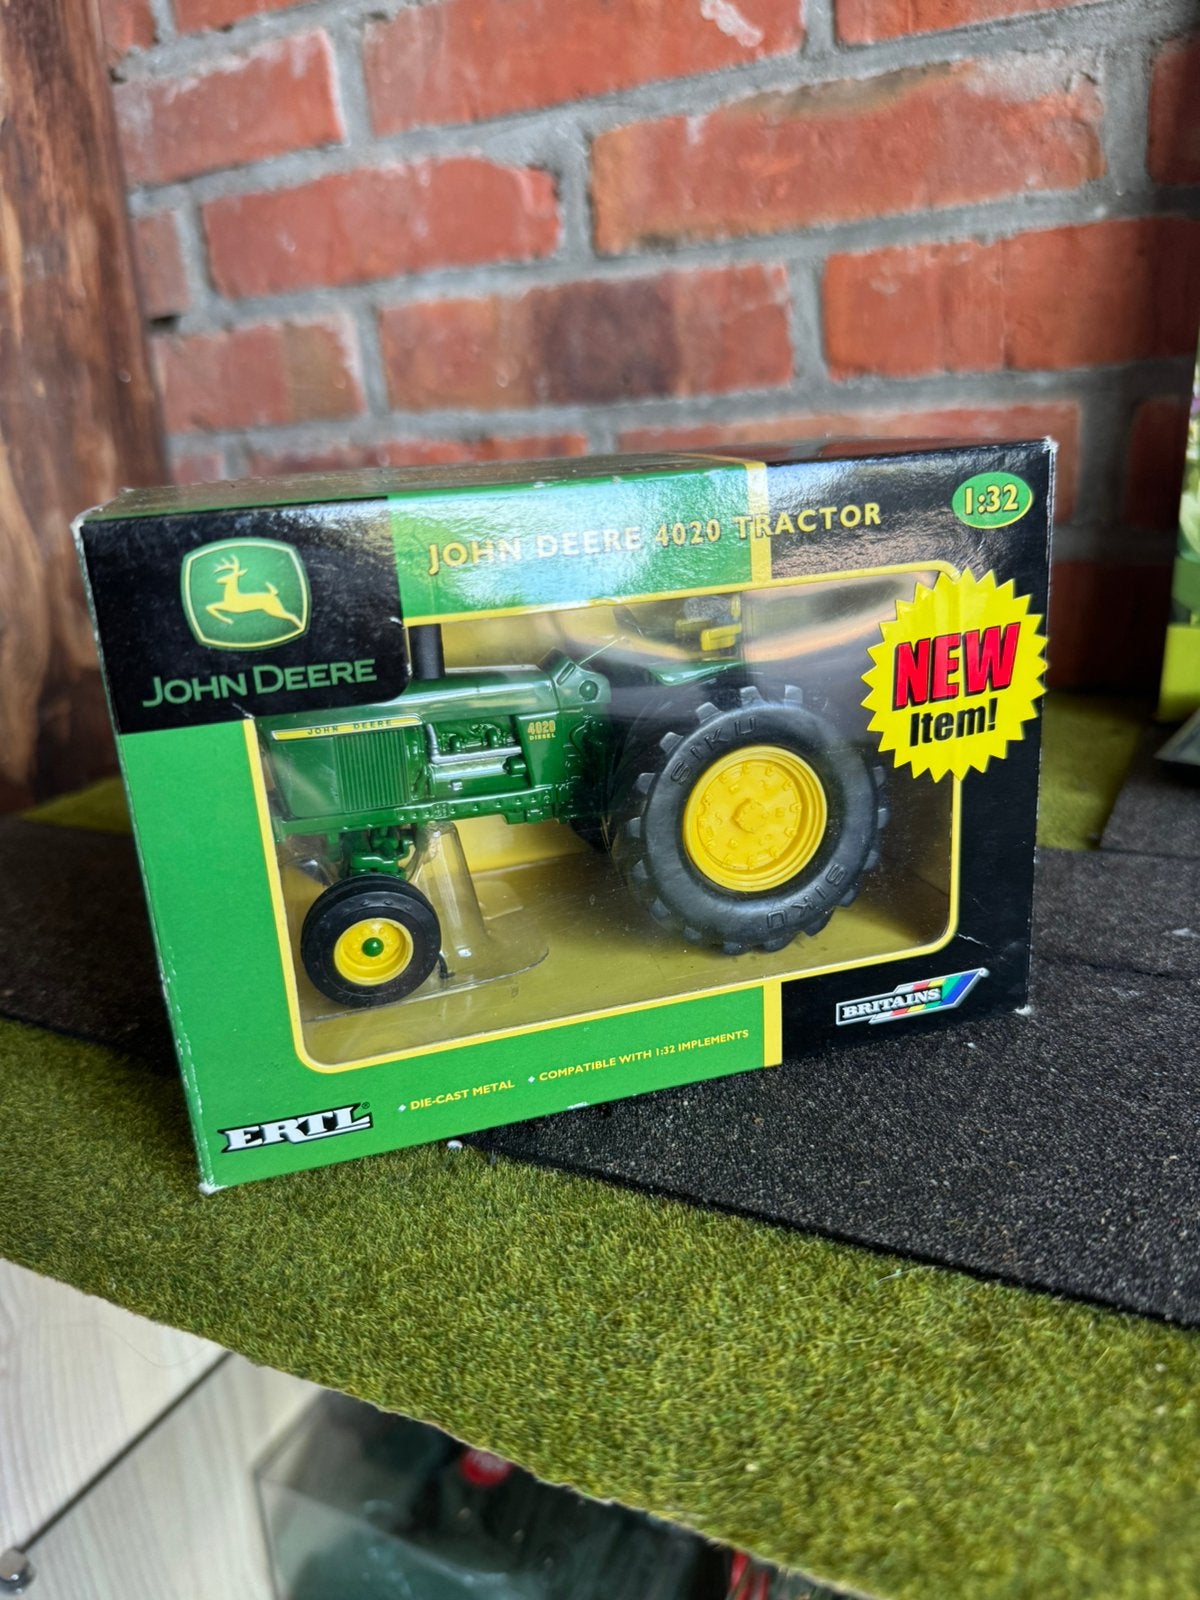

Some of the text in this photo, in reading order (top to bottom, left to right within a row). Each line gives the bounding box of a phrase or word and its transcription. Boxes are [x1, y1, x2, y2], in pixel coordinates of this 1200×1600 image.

[963, 482, 1019, 515] 1:32
[429, 501, 882, 576] JOHN DEERE 4020 TRACTOR
[142, 659, 377, 708] JOHN DEERE
[892, 622, 1021, 711] NEW
[307, 719, 392, 735] JOHN DEERE
[529, 733, 556, 741] DIESEL
[909, 698, 998, 747] Item!
[670, 718, 756, 786] SIKU
[842, 987, 942, 1020] BRITAINS
[539, 1029, 749, 1081] COMPATIBLE WITH 1:32 IMPLEMENTS
[410, 1080, 515, 1110] DIE-CAST METAL
